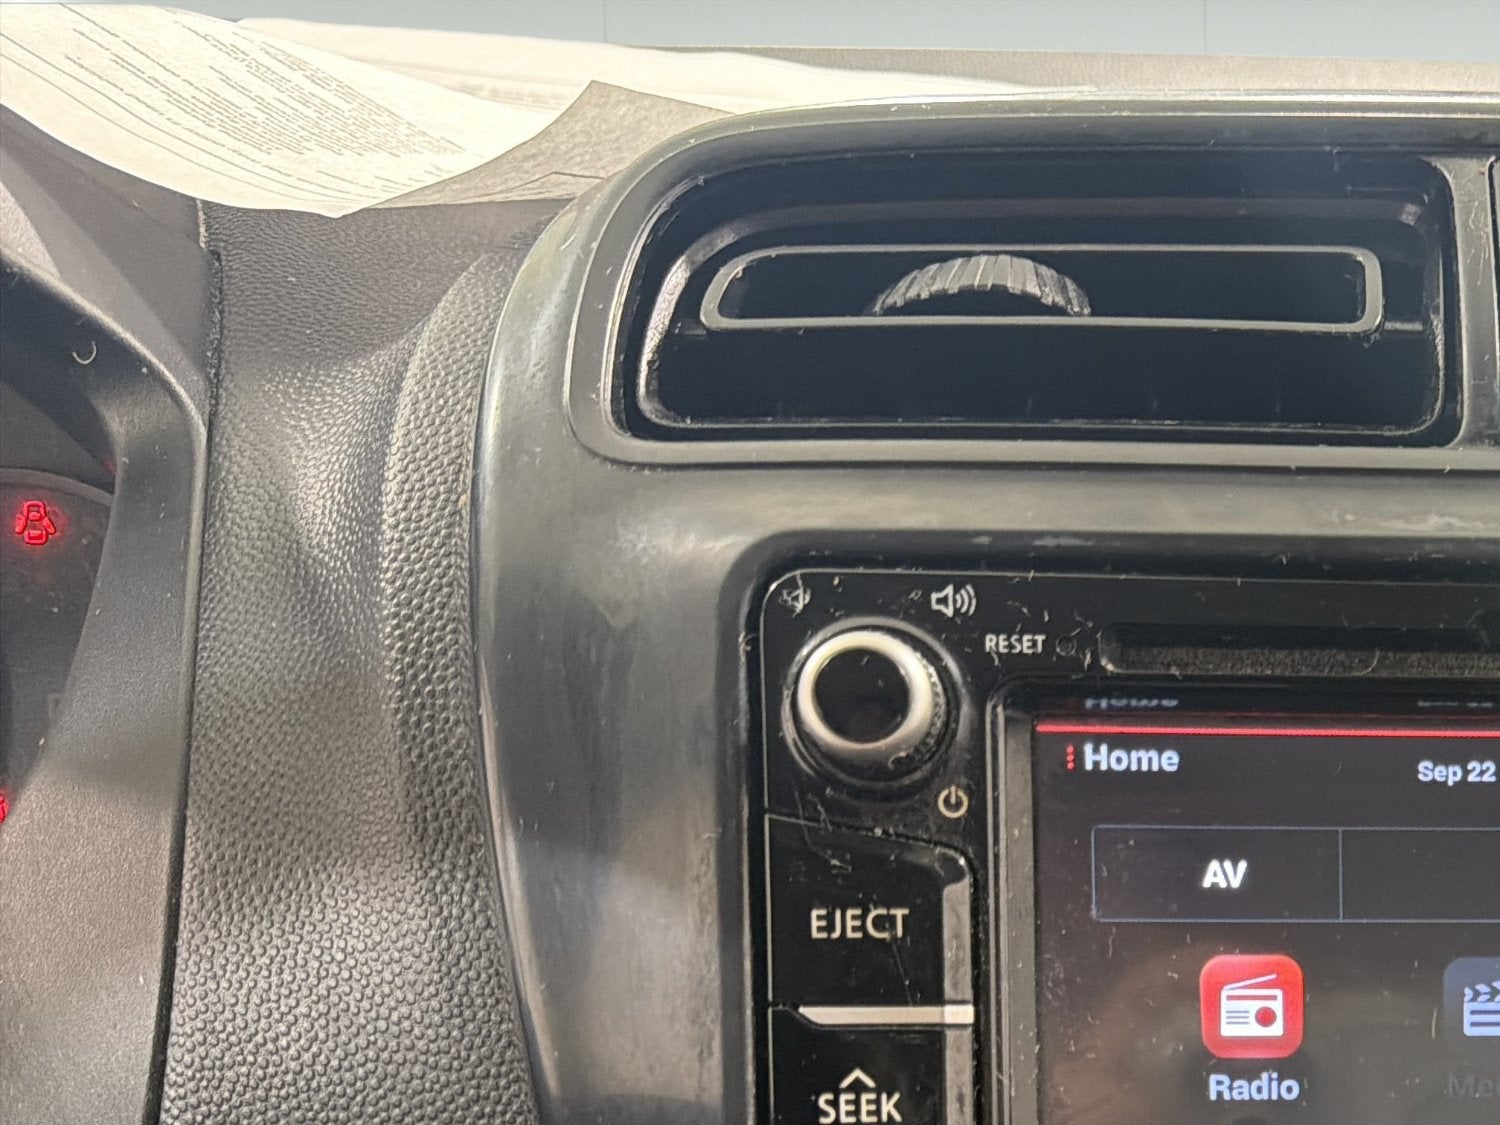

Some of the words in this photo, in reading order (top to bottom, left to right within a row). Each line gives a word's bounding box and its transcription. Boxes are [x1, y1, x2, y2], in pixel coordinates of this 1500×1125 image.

[985, 634, 1046, 655] RESET
[1084, 743, 1180, 772] Home
[1417, 761, 1463, 786] Sep
[1467, 760, 1497, 783] 22
[1202, 858, 1248, 888] AV
[810, 907, 910, 939] EJECT
[1208, 1071, 1300, 1101] Radio
[818, 1091, 902, 1125] SEEK
